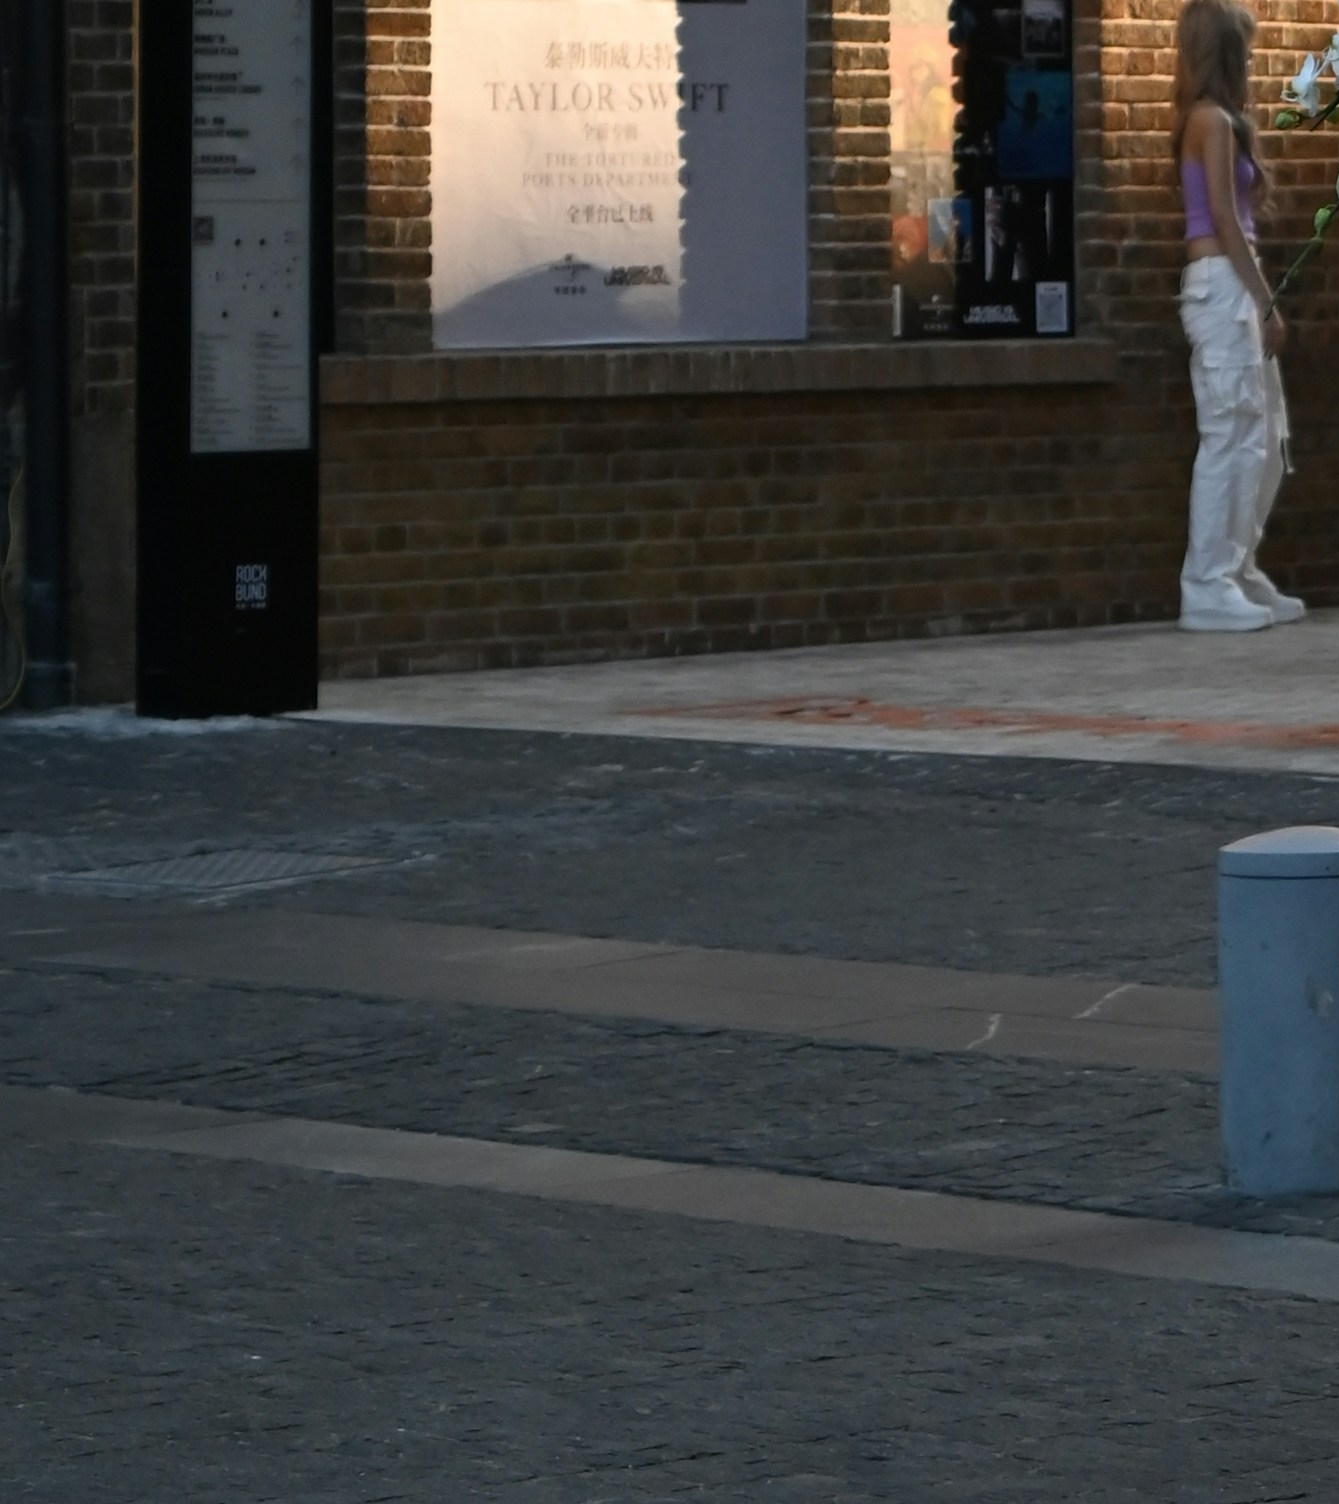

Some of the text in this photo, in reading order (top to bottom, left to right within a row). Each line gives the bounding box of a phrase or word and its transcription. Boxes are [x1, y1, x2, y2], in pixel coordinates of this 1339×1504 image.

[545, 41, 674, 70] 泰勒斯威夫特
[484, 81, 731, 113] TAYLOR SWIFT
[236, 564, 268, 582] ROCK
[235, 582, 267, 601] BUND
